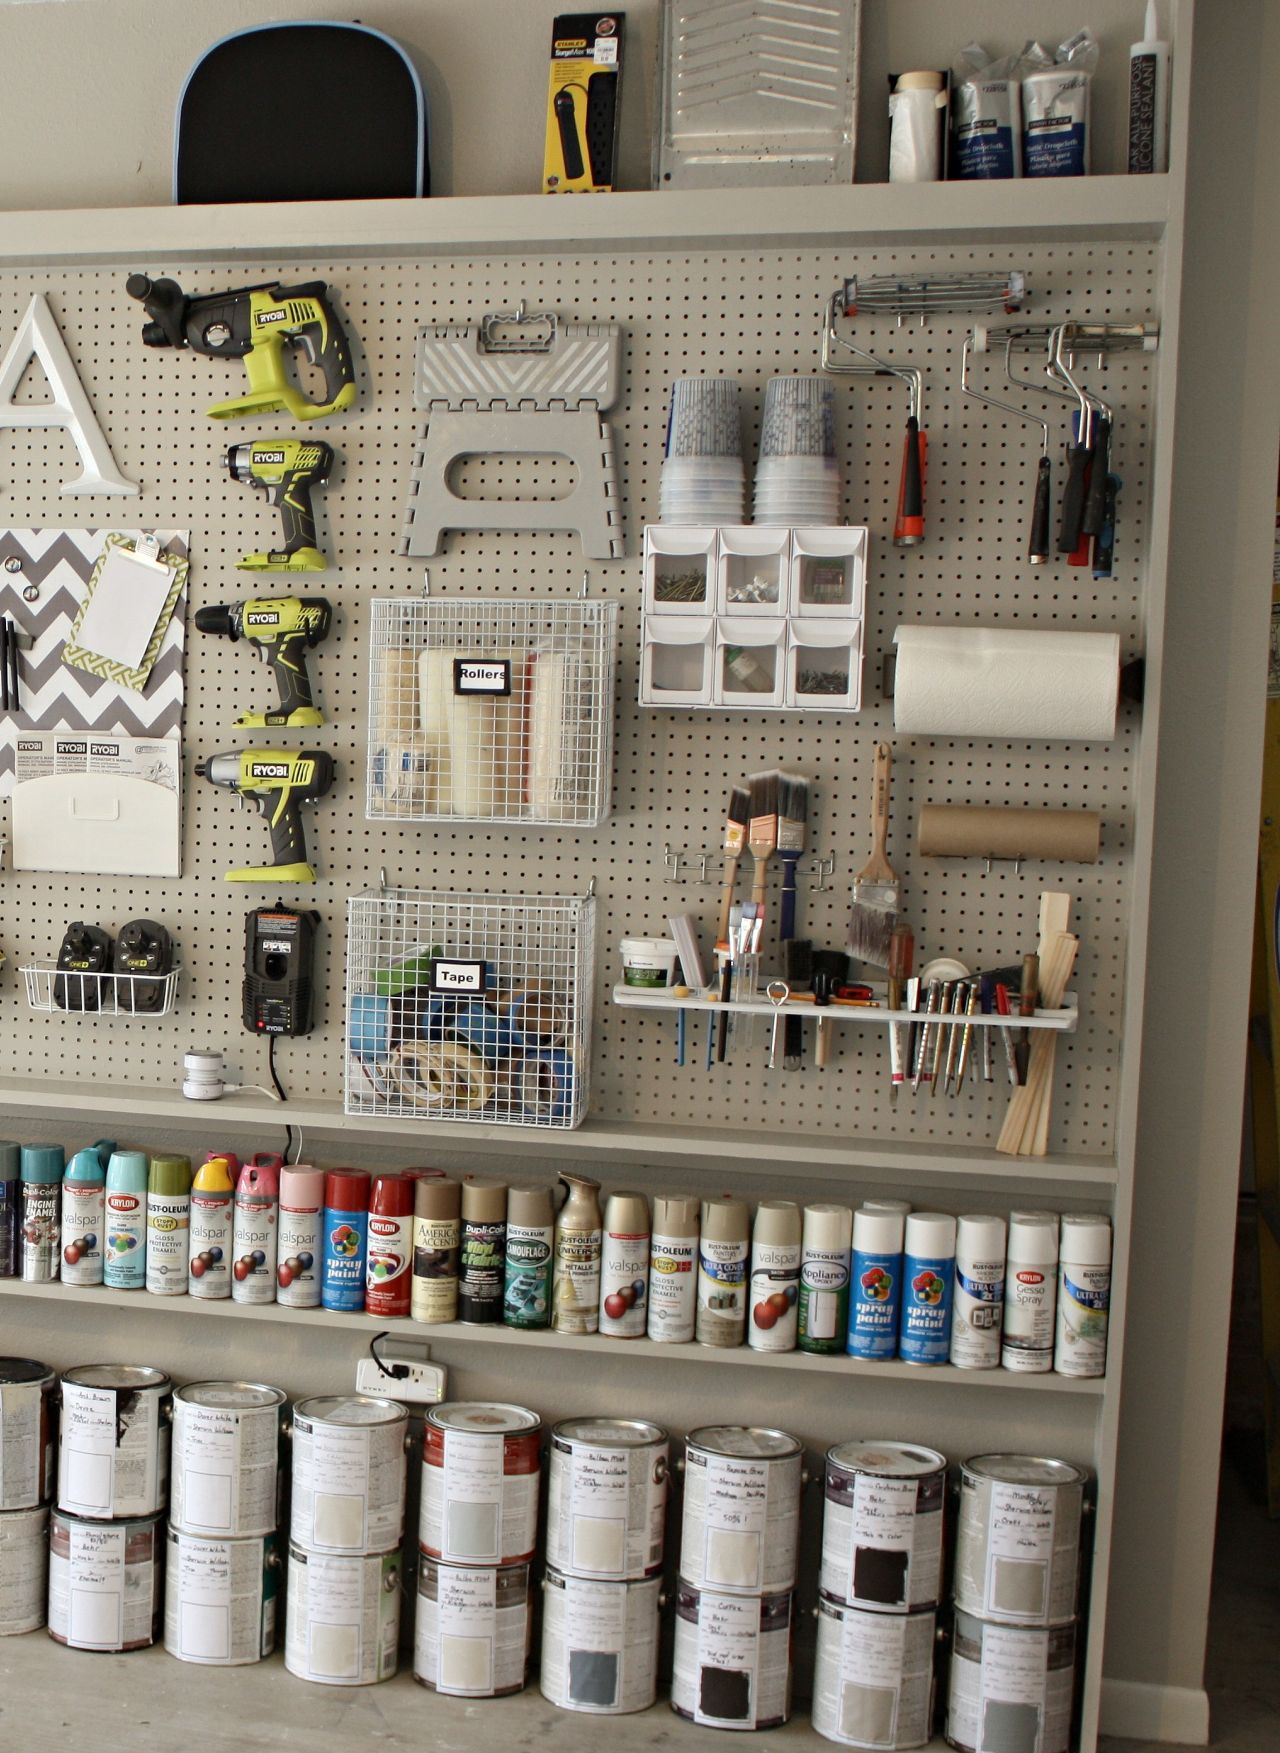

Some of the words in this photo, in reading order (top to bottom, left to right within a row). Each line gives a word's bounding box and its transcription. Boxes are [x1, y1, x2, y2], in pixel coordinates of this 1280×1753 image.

[556, 40, 586, 49] STANLEY
[1139, 61, 1153, 119] SEALANT
[259, 310, 286, 322] RYOBI
[254, 453, 283, 463] RYOBI
[248, 613, 278, 624] RYOBI
[461, 668, 505, 680] Rollers
[18, 743, 42, 751] RYOBI
[58, 743, 87, 753] RYOBI
[92, 744, 119, 756] RYOBI
[254, 765, 288, 777] RYOBI
[441, 971, 474, 984] Tape
[27, 1199, 57, 1209] ENGINE
[110, 1198, 138, 1210] KRYLON
[25, 1207, 57, 1217] ENAMEL
[63, 1213, 100, 1227] valspar
[191, 1226, 227, 1241] valspar
[371, 1221, 398, 1234] KRYLON
[466, 1224, 506, 1234] Dupli-Colo
[154, 1233, 175, 1241] GLOSS
[278, 1230, 314, 1246] valspar
[150, 1239, 182, 1248] PROTECTIVE
[153, 1245, 177, 1254] ENAMEL
[506, 1243, 549, 1257] CAMOUFLAGE
[759, 1251, 798, 1266] valspar
[327, 1258, 363, 1272] spray
[565, 1263, 594, 1271] METALLIC
[607, 1258, 648, 1275] valspar
[328, 1267, 361, 1280] paint
[801, 1267, 848, 1280] Appliance
[1018, 1272, 1043, 1282] KRYLON
[655, 1277, 677, 1286] GLOSS
[1017, 1284, 1045, 1296] Gesso
[1016, 1294, 1043, 1306] Spray
[856, 1304, 894, 1316] spray
[907, 1308, 945, 1320] spray
[857, 1313, 893, 1324] paint
[908, 1317, 944, 1329] paint
[718, 1601, 744, 1612] Coffee
